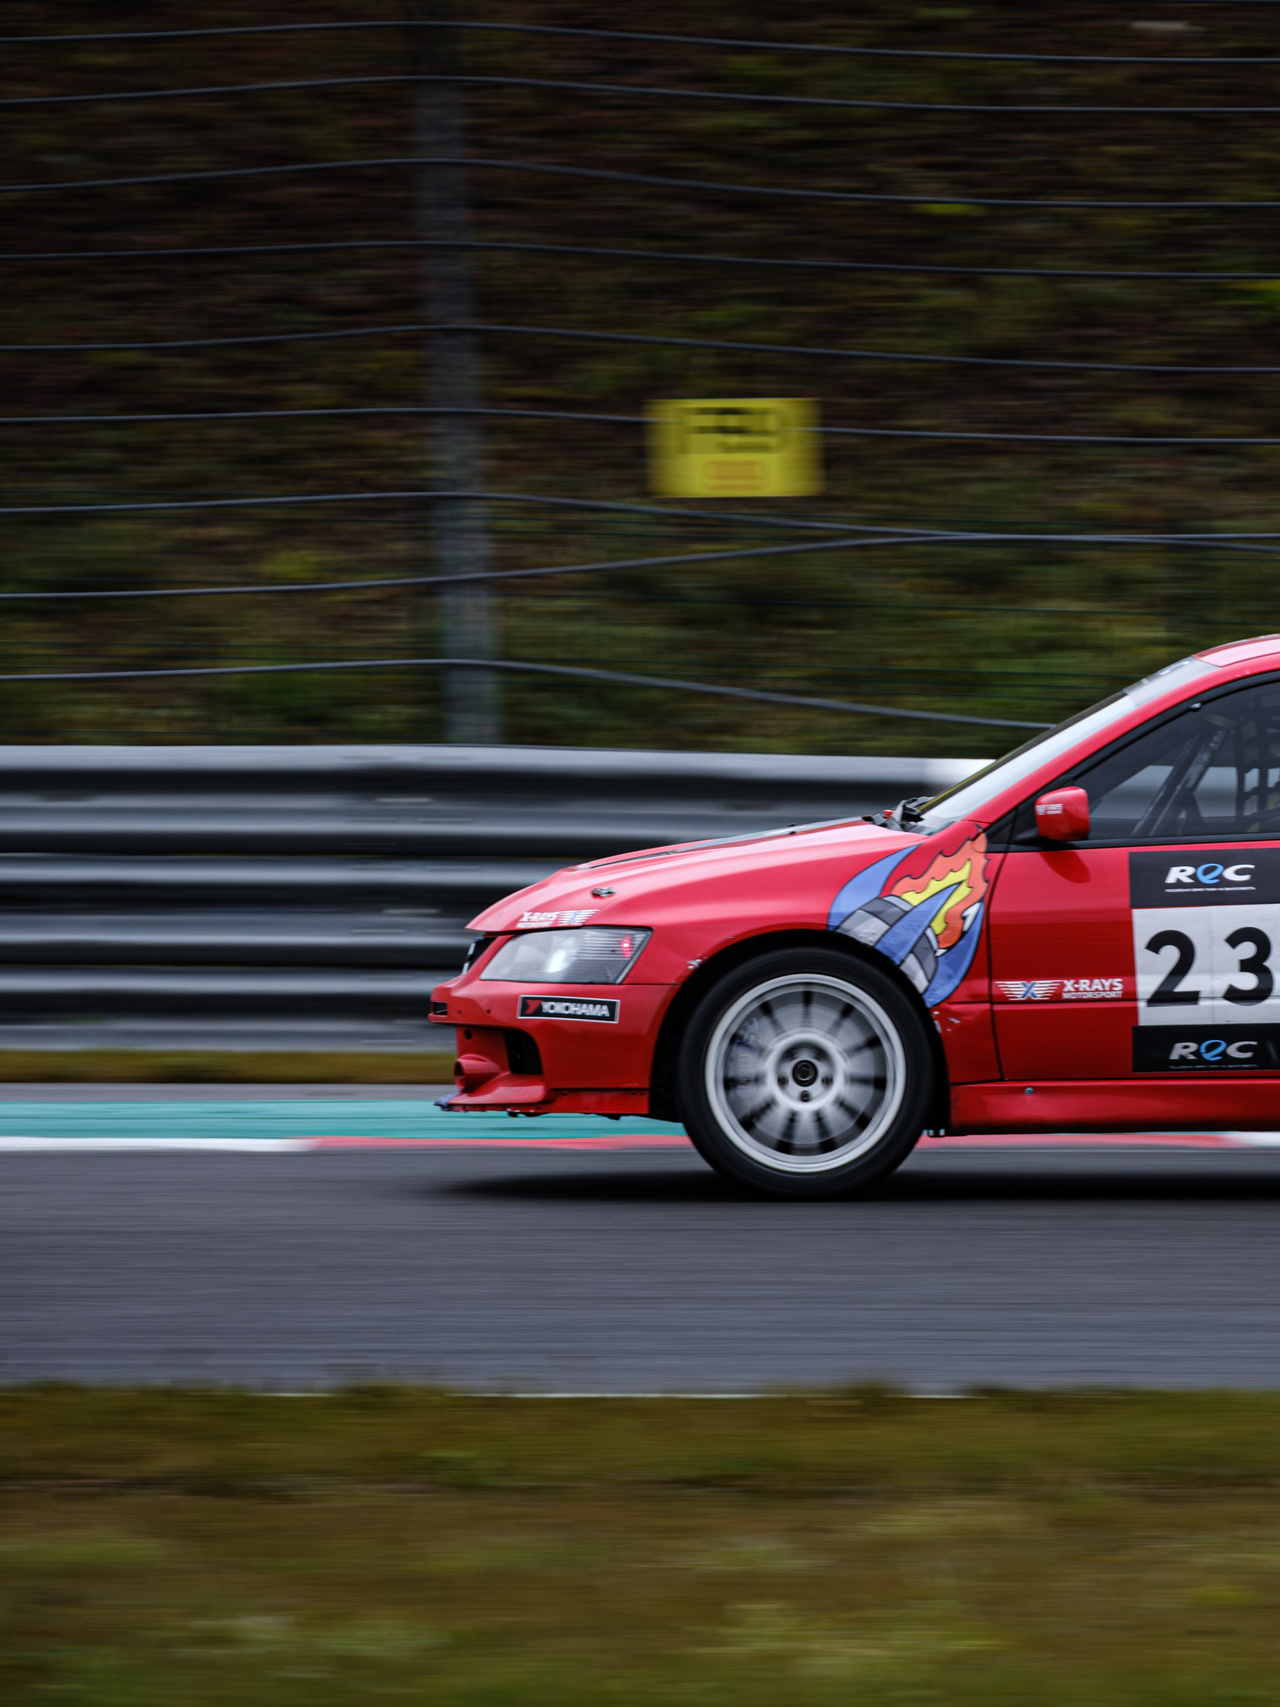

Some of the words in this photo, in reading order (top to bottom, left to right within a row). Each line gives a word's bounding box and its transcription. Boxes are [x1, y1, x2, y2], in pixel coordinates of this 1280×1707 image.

[1145, 926, 1275, 1007] 23
[1062, 978, 1124, 992] X-RAYS
[541, 1001, 610, 1017] YOKOHAMA
